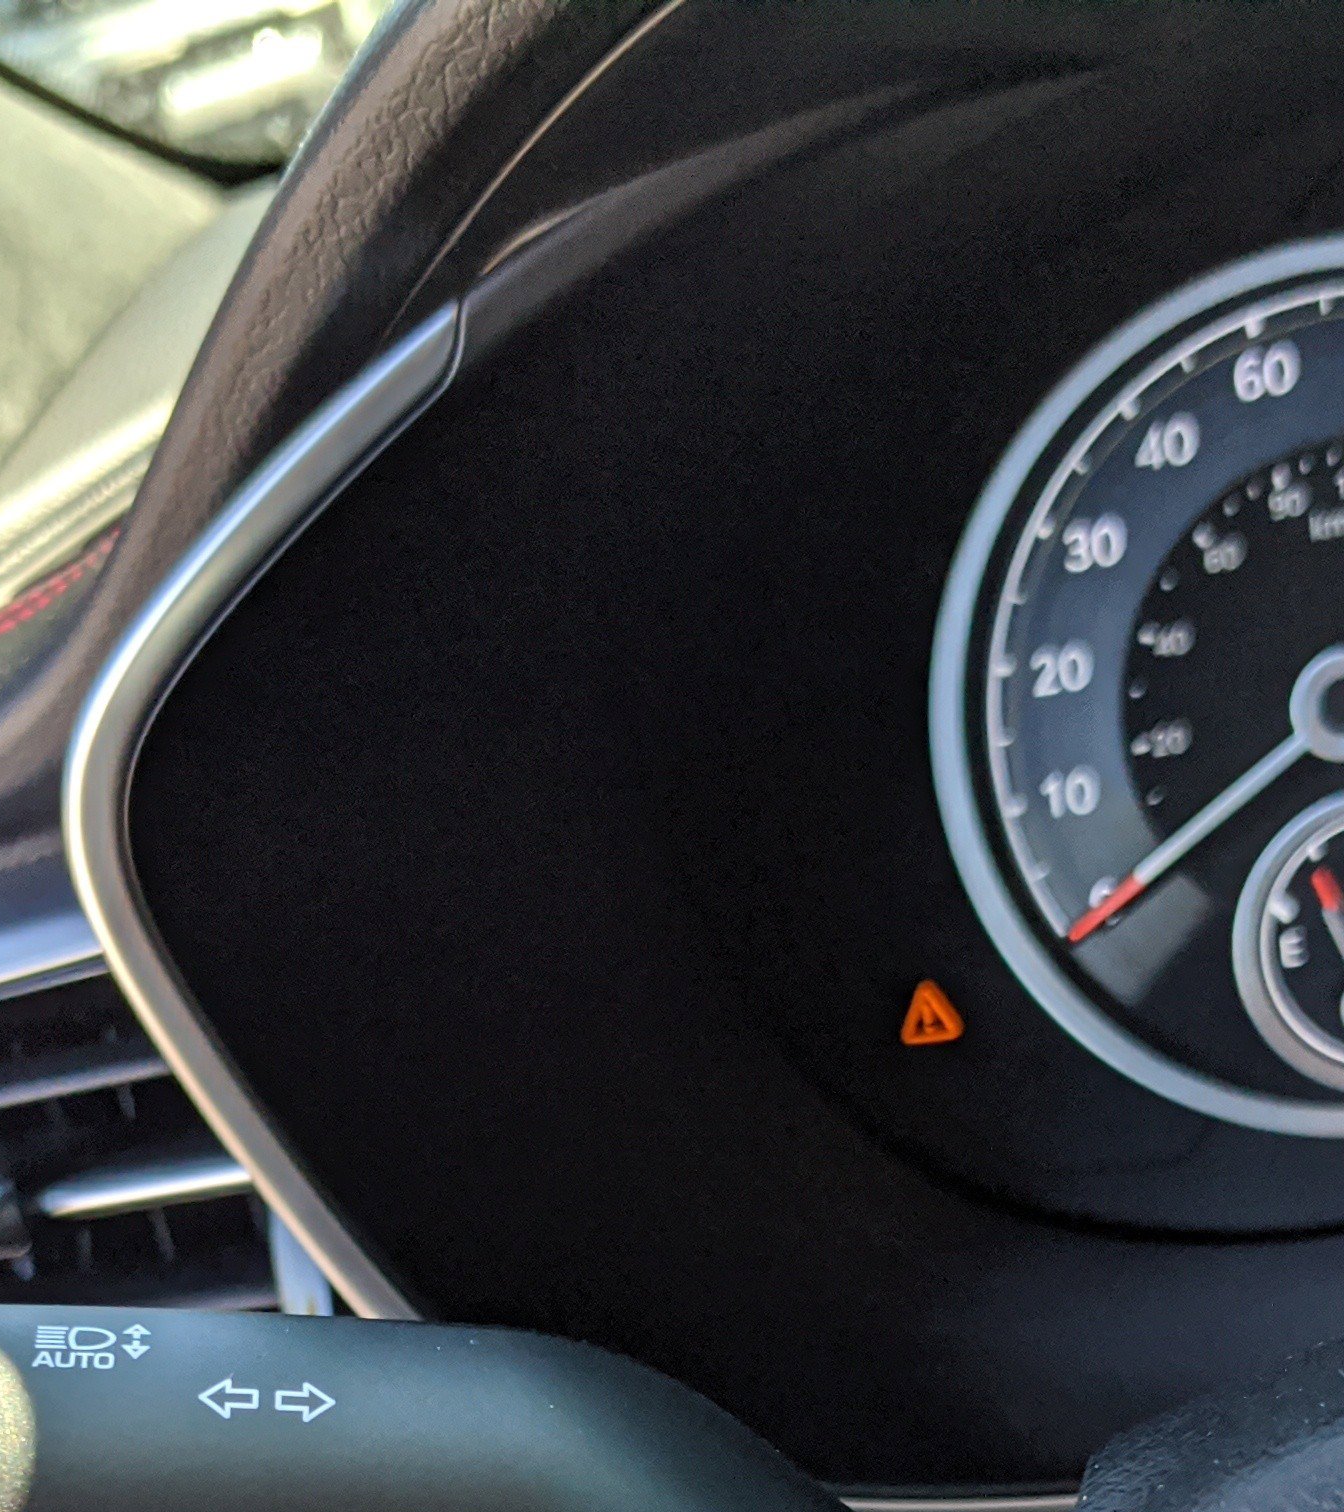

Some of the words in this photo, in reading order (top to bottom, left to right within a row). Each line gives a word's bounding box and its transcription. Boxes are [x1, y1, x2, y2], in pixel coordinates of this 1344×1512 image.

[1234, 340, 1300, 402] 60
[1135, 411, 1200, 471] 40
[1063, 512, 1128, 574] 30
[1030, 640, 1093, 700] 20
[1039, 763, 1101, 818] 10
[32, 1350, 115, 1369] AUTO
